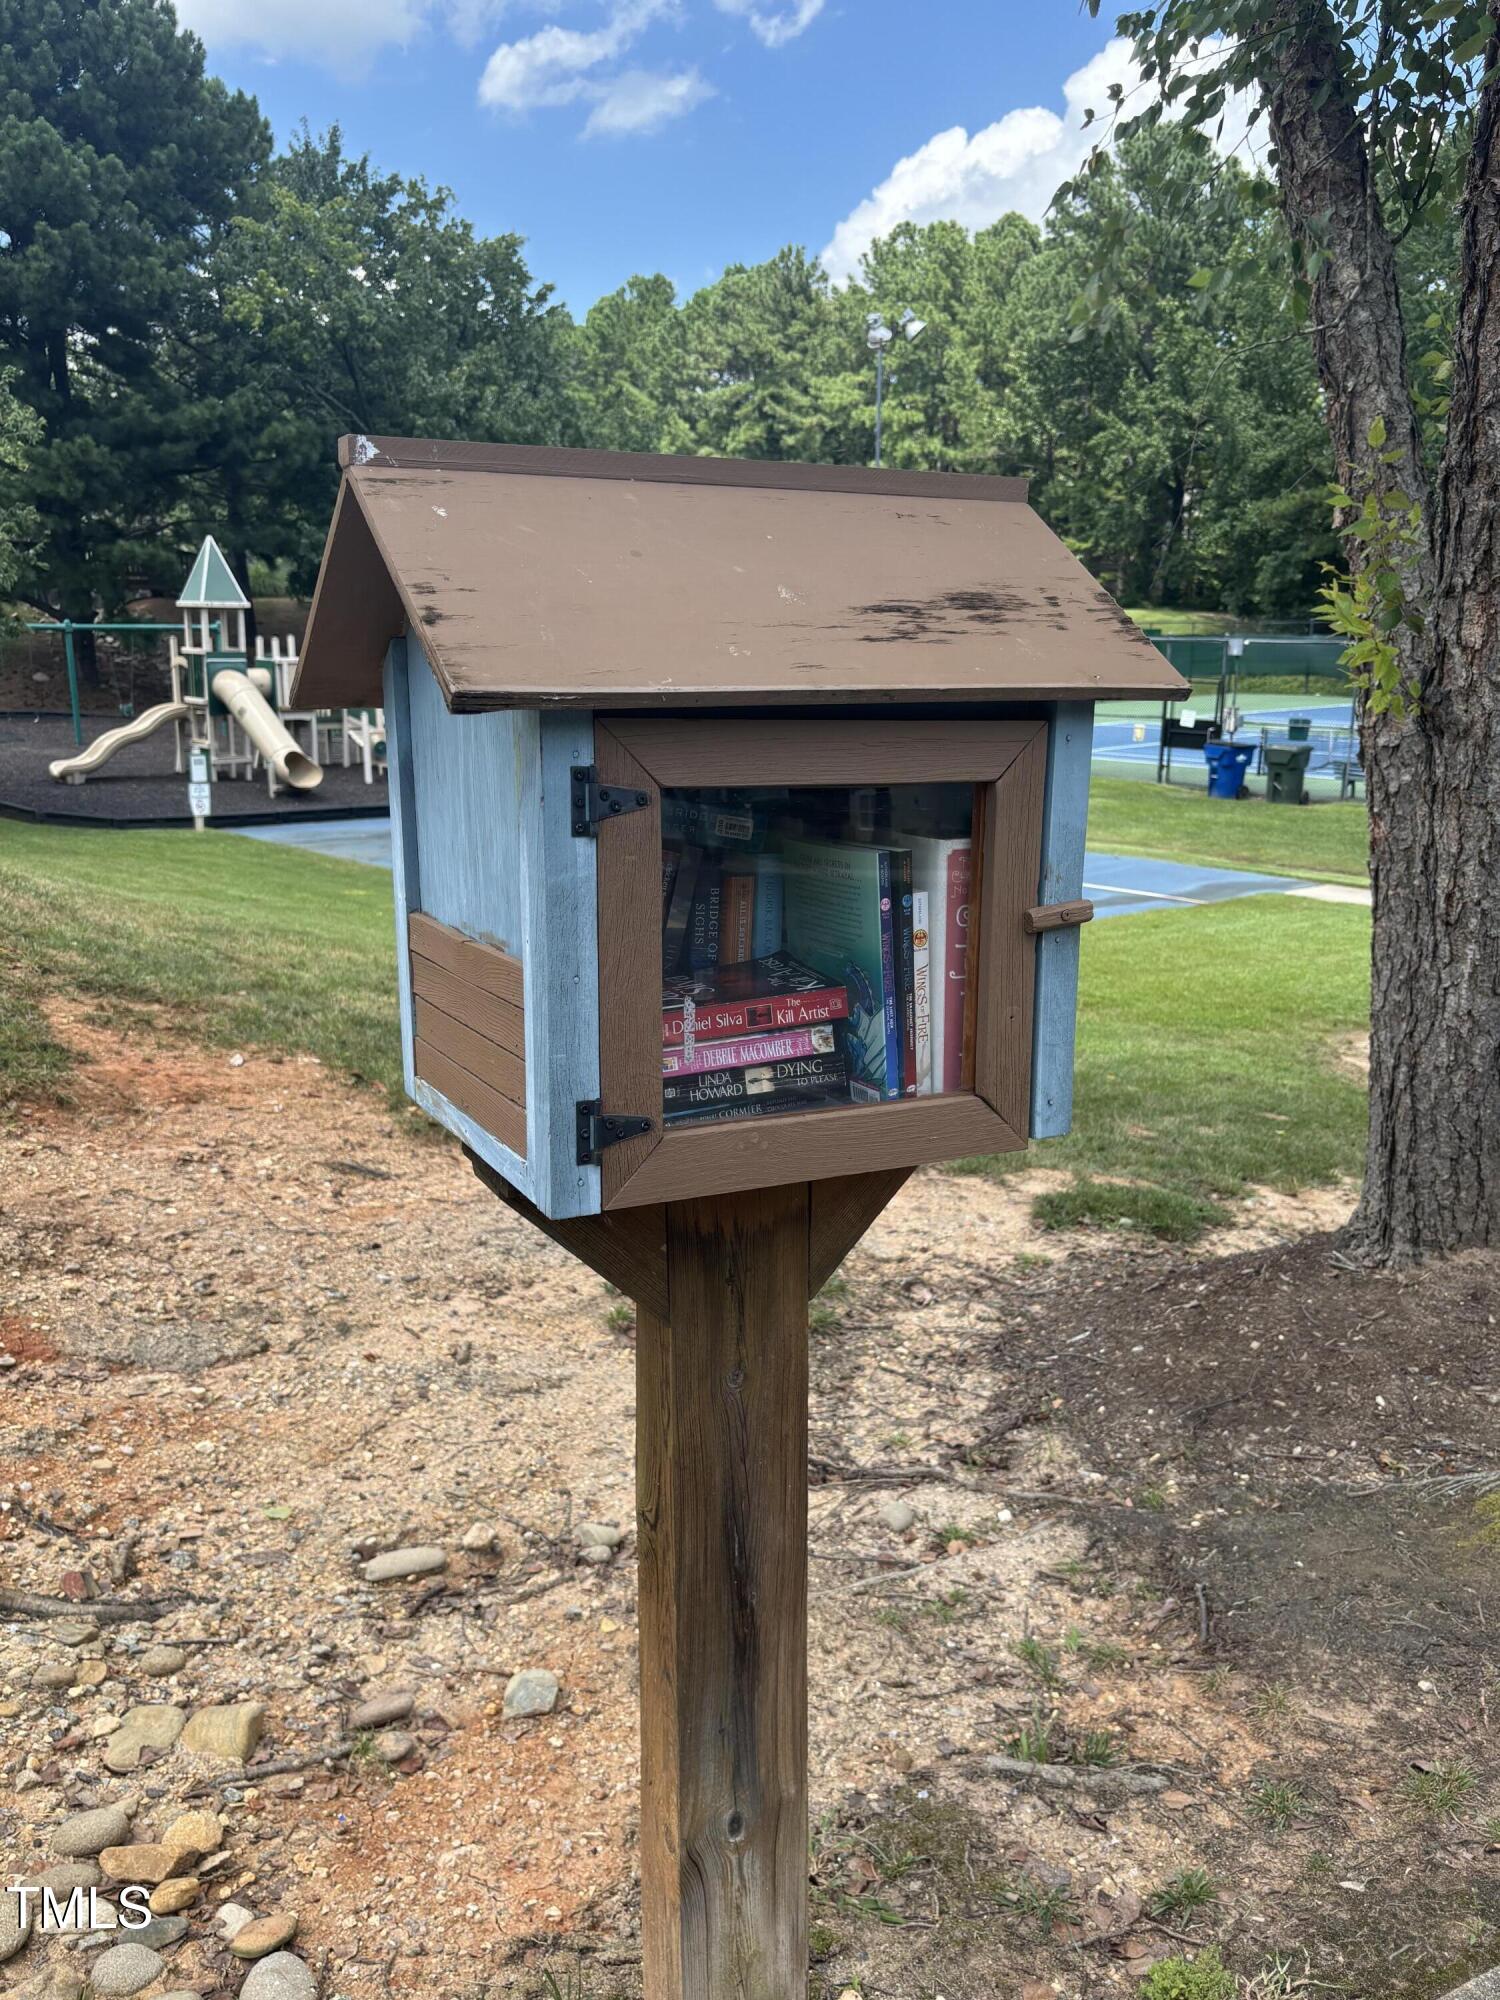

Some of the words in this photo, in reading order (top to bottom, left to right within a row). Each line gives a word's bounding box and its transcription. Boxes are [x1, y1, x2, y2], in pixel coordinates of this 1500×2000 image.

[694, 903, 706, 944] SIGHS
[708, 887, 720, 939] BRIDGE
[707, 943, 718, 961] OF
[882, 932, 892, 962] WINGS
[902, 927, 913, 960] WINGS
[915, 963, 929, 1006] WINGS
[785, 998, 801, 1007] The
[672, 1016, 711, 1035] Dniel
[716, 1013, 743, 1028] Silva
[776, 1009, 794, 1025] Kill
[798, 1005, 830, 1021] Artist
[916, 1014, 930, 1043] FIRE
[703, 1046, 738, 1068] DEBBIE
[740, 1039, 794, 1064] MACOMBER
[777, 1059, 823, 1079] DYING
[796, 1078, 808, 1086] TO
[810, 1073, 839, 1085] PLEASE
[698, 1072, 732, 1088] LINDA
[689, 1083, 743, 1102] HOWARD
[719, 1103, 763, 1119] CORMIER
